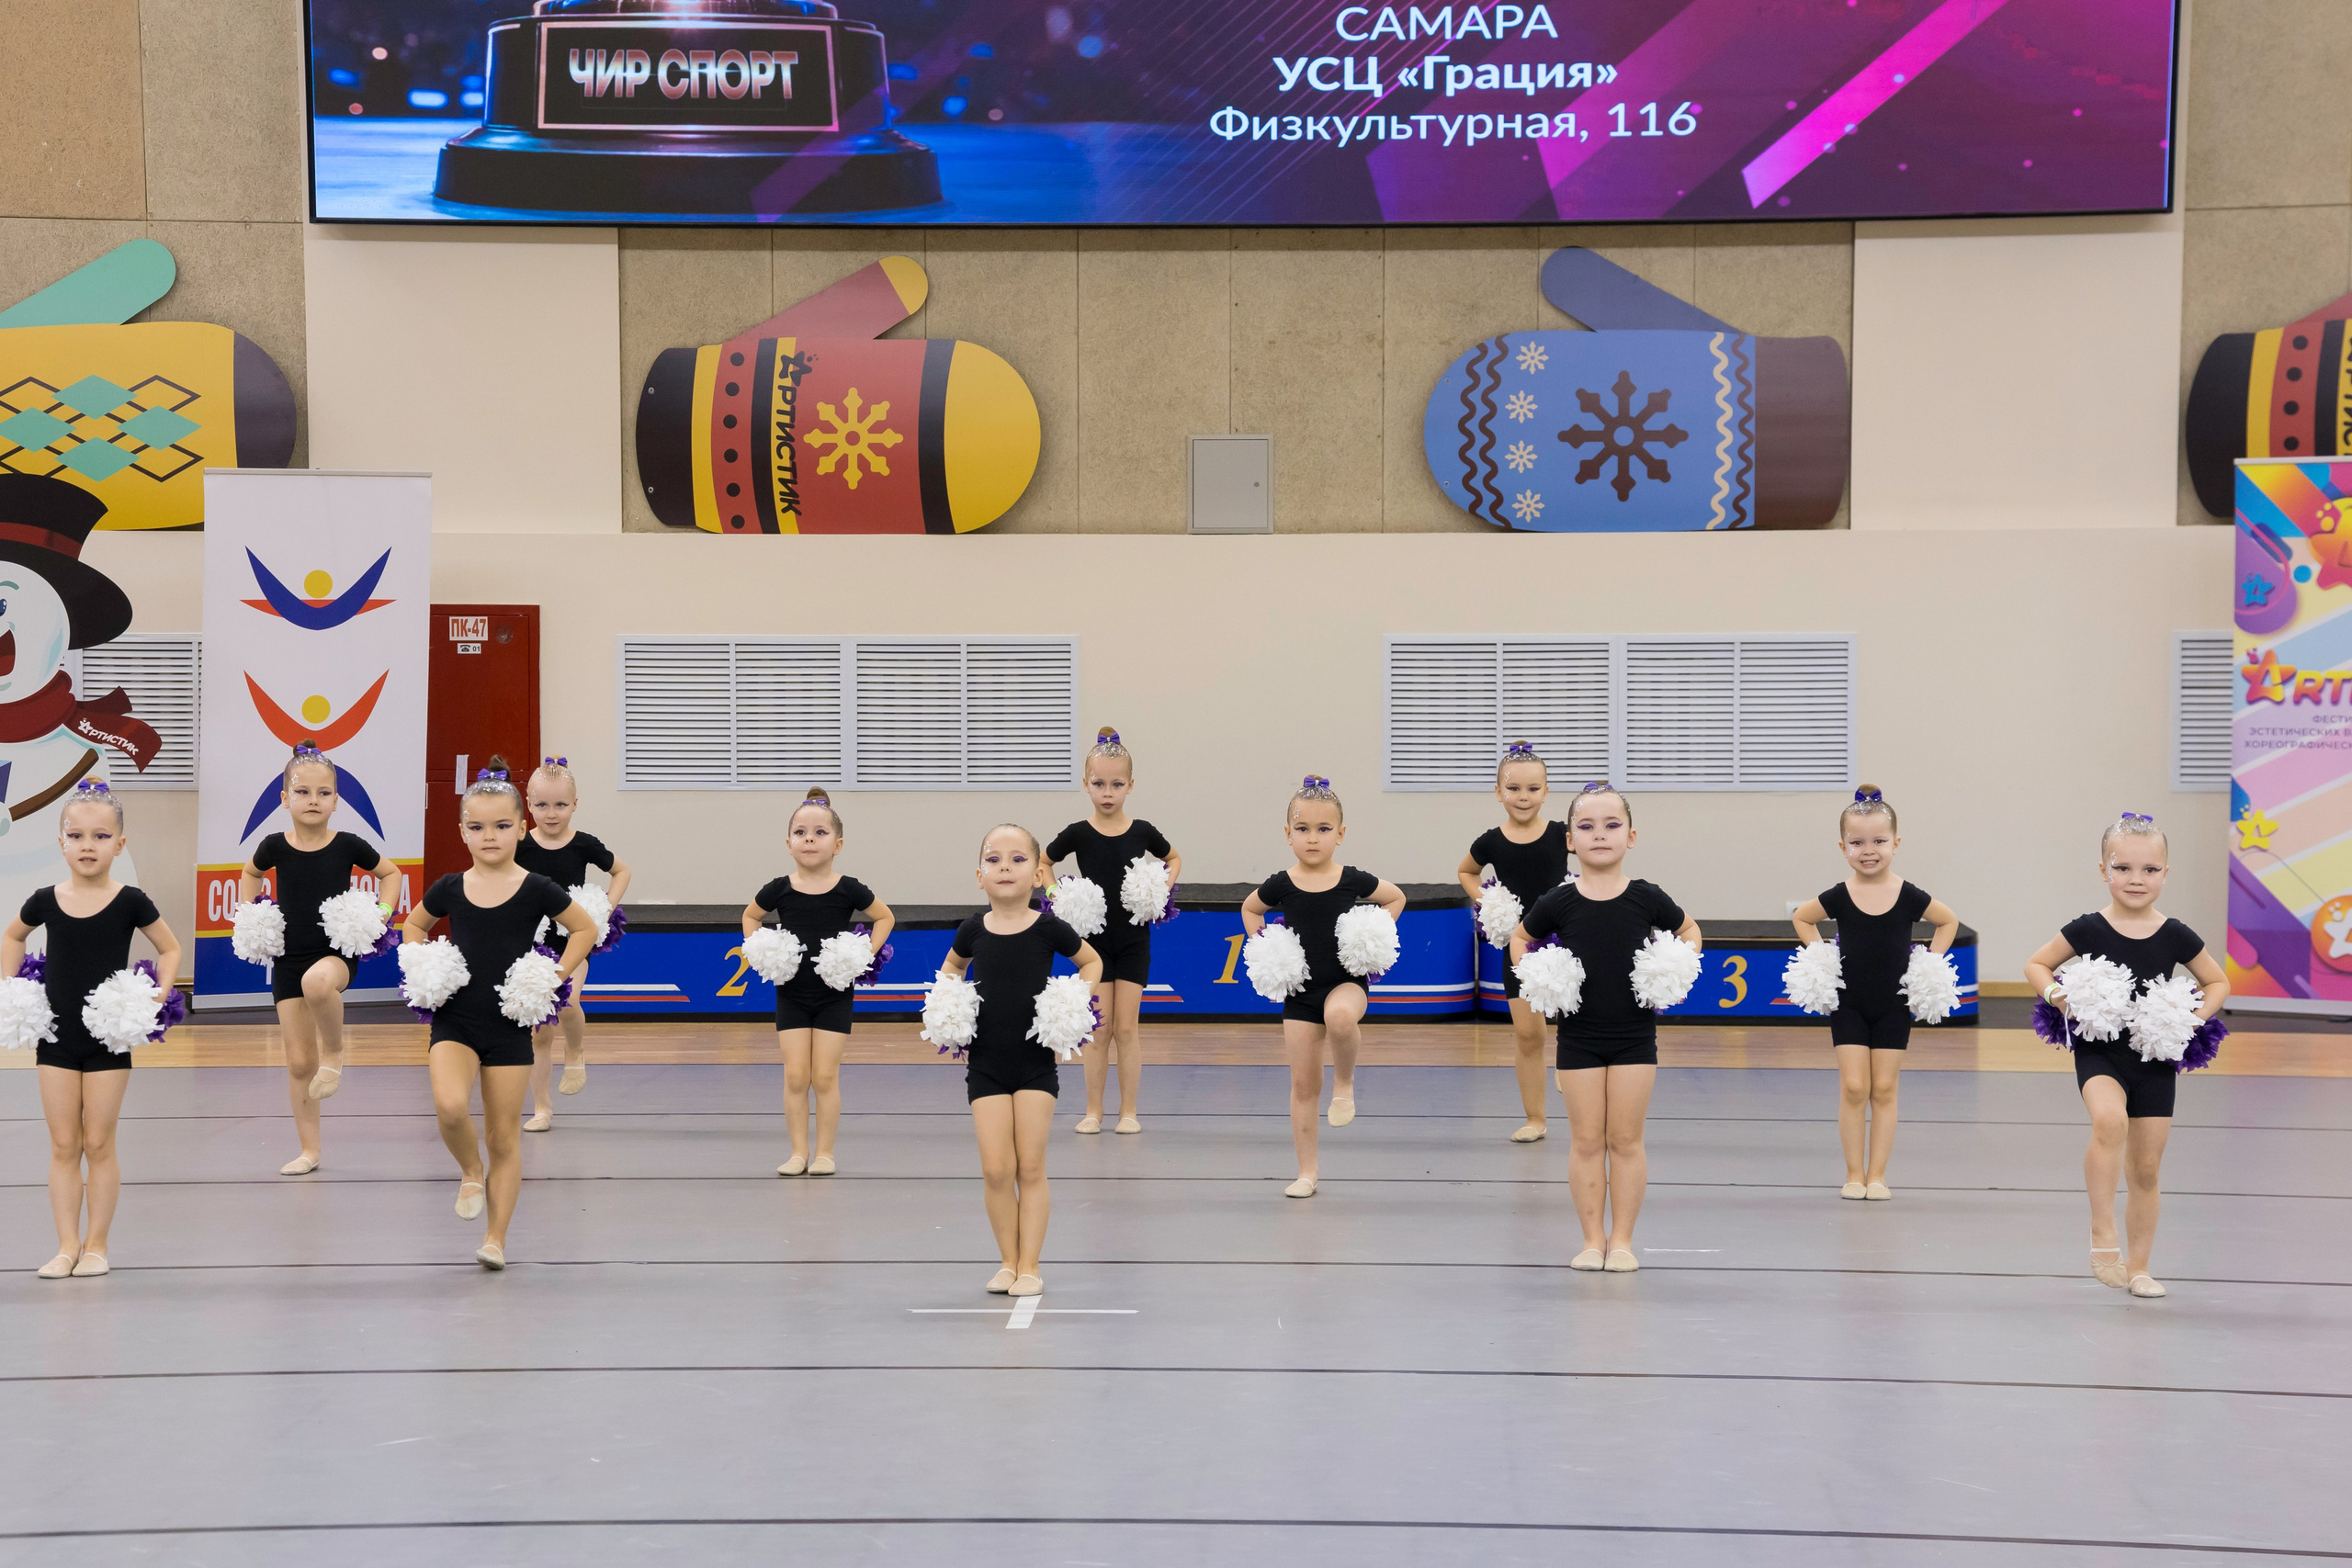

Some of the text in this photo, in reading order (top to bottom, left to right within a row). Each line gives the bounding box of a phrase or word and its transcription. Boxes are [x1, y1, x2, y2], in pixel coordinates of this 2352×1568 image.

[1335, 5, 1559, 41] САМАРА
[569, 49, 798, 99] ЧИР СПОРТ
[1273, 56, 1619, 97] УСЦ «Грация»
[1209, 102, 1698, 147] Физкультурная, 116
[451, 618, 487, 637] ПК-47
[2249, 727, 2341, 736] ЭСТЕТИЧЕСКИХ
[716, 946, 750, 997] 2
[1213, 933, 1245, 984] 1
[1719, 955, 1747, 1009] 3
